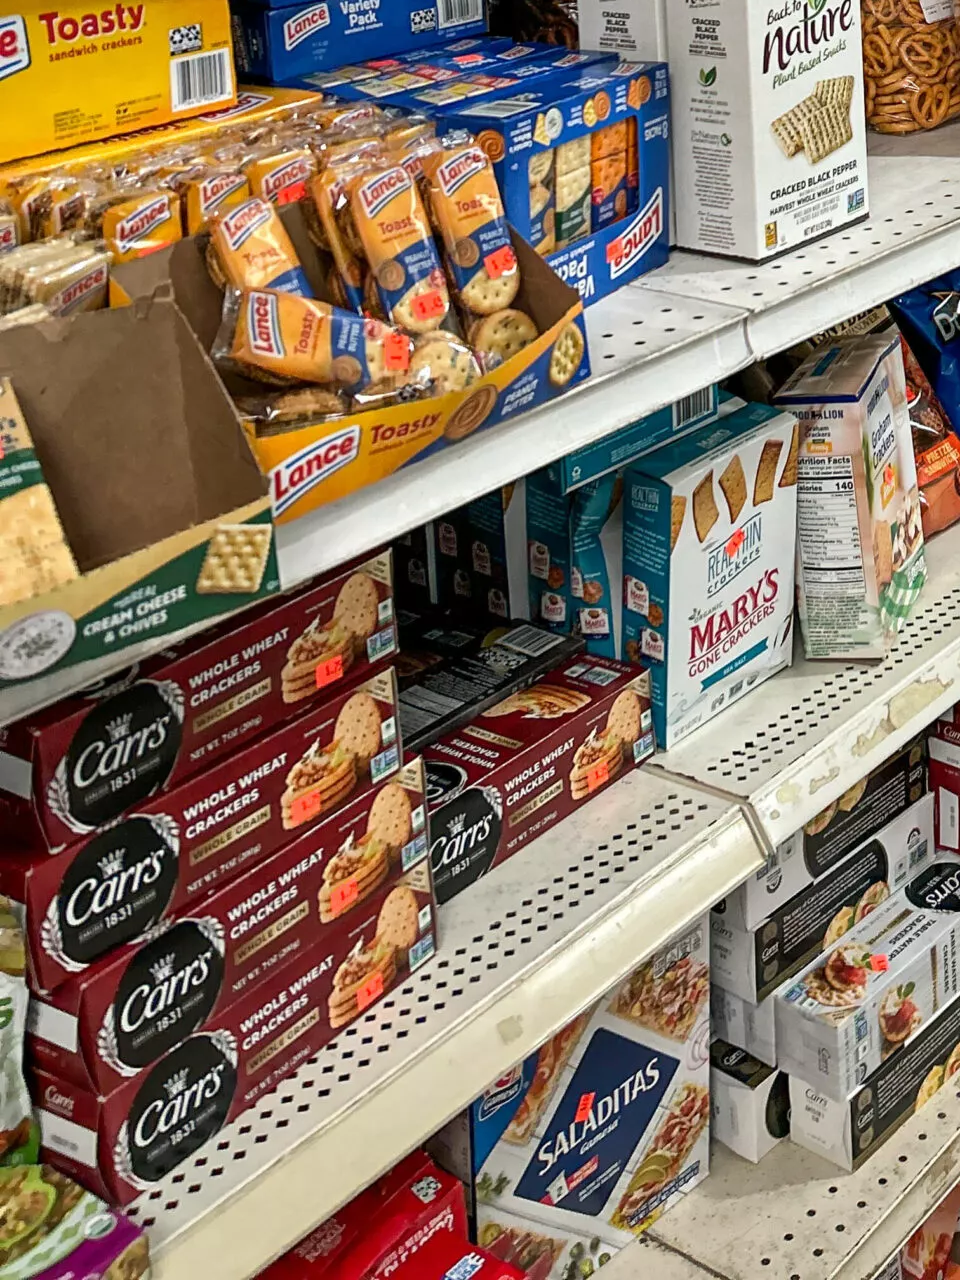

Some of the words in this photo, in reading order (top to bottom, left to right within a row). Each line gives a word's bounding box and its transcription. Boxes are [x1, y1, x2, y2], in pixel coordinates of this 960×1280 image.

[39, 2, 146, 46] Toasty
[285, 7, 328, 41] Lance
[348, 10, 378, 28] Pack
[766, 3, 791, 26] Back
[790, 0, 802, 15] to
[48, 42, 98, 63] sandwich
[101, 35, 143, 54] crackers
[772, 71, 797, 90] Plant
[797, 58, 822, 78] Based
[822, 39, 847, 64] Snacks
[264, 161, 307, 196] Lance
[361, 170, 405, 209] Lance
[438, 153, 483, 188] Lance
[770, 180, 807, 201] CRACKED
[807, 170, 831, 187] BLACK
[832, 159, 858, 177] PEPPER
[769, 201, 795, 216] HARVEST
[797, 193, 816, 206] WHOLE
[817, 185, 834, 198] WHEAT
[835, 175, 859, 191] CRACKERS
[118, 200, 169, 242] Lance
[253, 295, 276, 354] Lance
[501, 392, 535, 417] BUTTER
[503, 379, 539, 405] PEANUT
[369, 411, 443, 445] Toasty
[822, 409, 844, 420] LION
[870, 412, 893, 450] Graham
[273, 434, 356, 502] Lance
[827, 456, 851, 464] Facts
[926, 442, 954, 464] PRETZEL
[835, 481, 854, 491] 140
[707, 548, 761, 594] crackers
[82, 604, 133, 638] CREAM
[135, 584, 188, 616] CHEESE
[103, 629, 115, 643] &
[118, 609, 168, 637] CHIVES
[688, 567, 780, 660] MARY'S
[188, 653, 240, 689] WHOLE
[241, 626, 291, 658] WHEAT
[688, 651, 722, 678] GONE
[721, 603, 777, 654] CRACKERS
[190, 661, 262, 708] CRACKERS
[73, 712, 171, 789] Carr's
[503, 760, 541, 792] WHOLE
[540, 736, 576, 767] WHEAT
[109, 770, 138, 793] 1831
[182, 782, 238, 823] WHOLE
[237, 752, 289, 792] WHEAT
[505, 766, 557, 807] CRACKERS
[184, 787, 261, 841] CRACKERS
[428, 811, 495, 872] Carr's
[66, 845, 167, 927] Carr's
[226, 878, 278, 922] WHOLE
[278, 847, 326, 889] WHEAT
[104, 904, 134, 929] 1831
[229, 884, 299, 941] CRACKERS
[887, 914, 927, 945] CRACKERS
[914, 918, 938, 939] TABLE
[119, 948, 213, 1034] Carr's
[238, 986, 288, 1034] WHOLE
[287, 954, 335, 997] WHEAT
[155, 1006, 184, 1032] 1831
[240, 992, 310, 1052] CRACKERS
[132, 1061, 226, 1147] Carr's
[537, 1056, 661, 1177] SALADITAS
[170, 1120, 197, 1146] 1831
[579, 1119, 620, 1155] Gamesa
